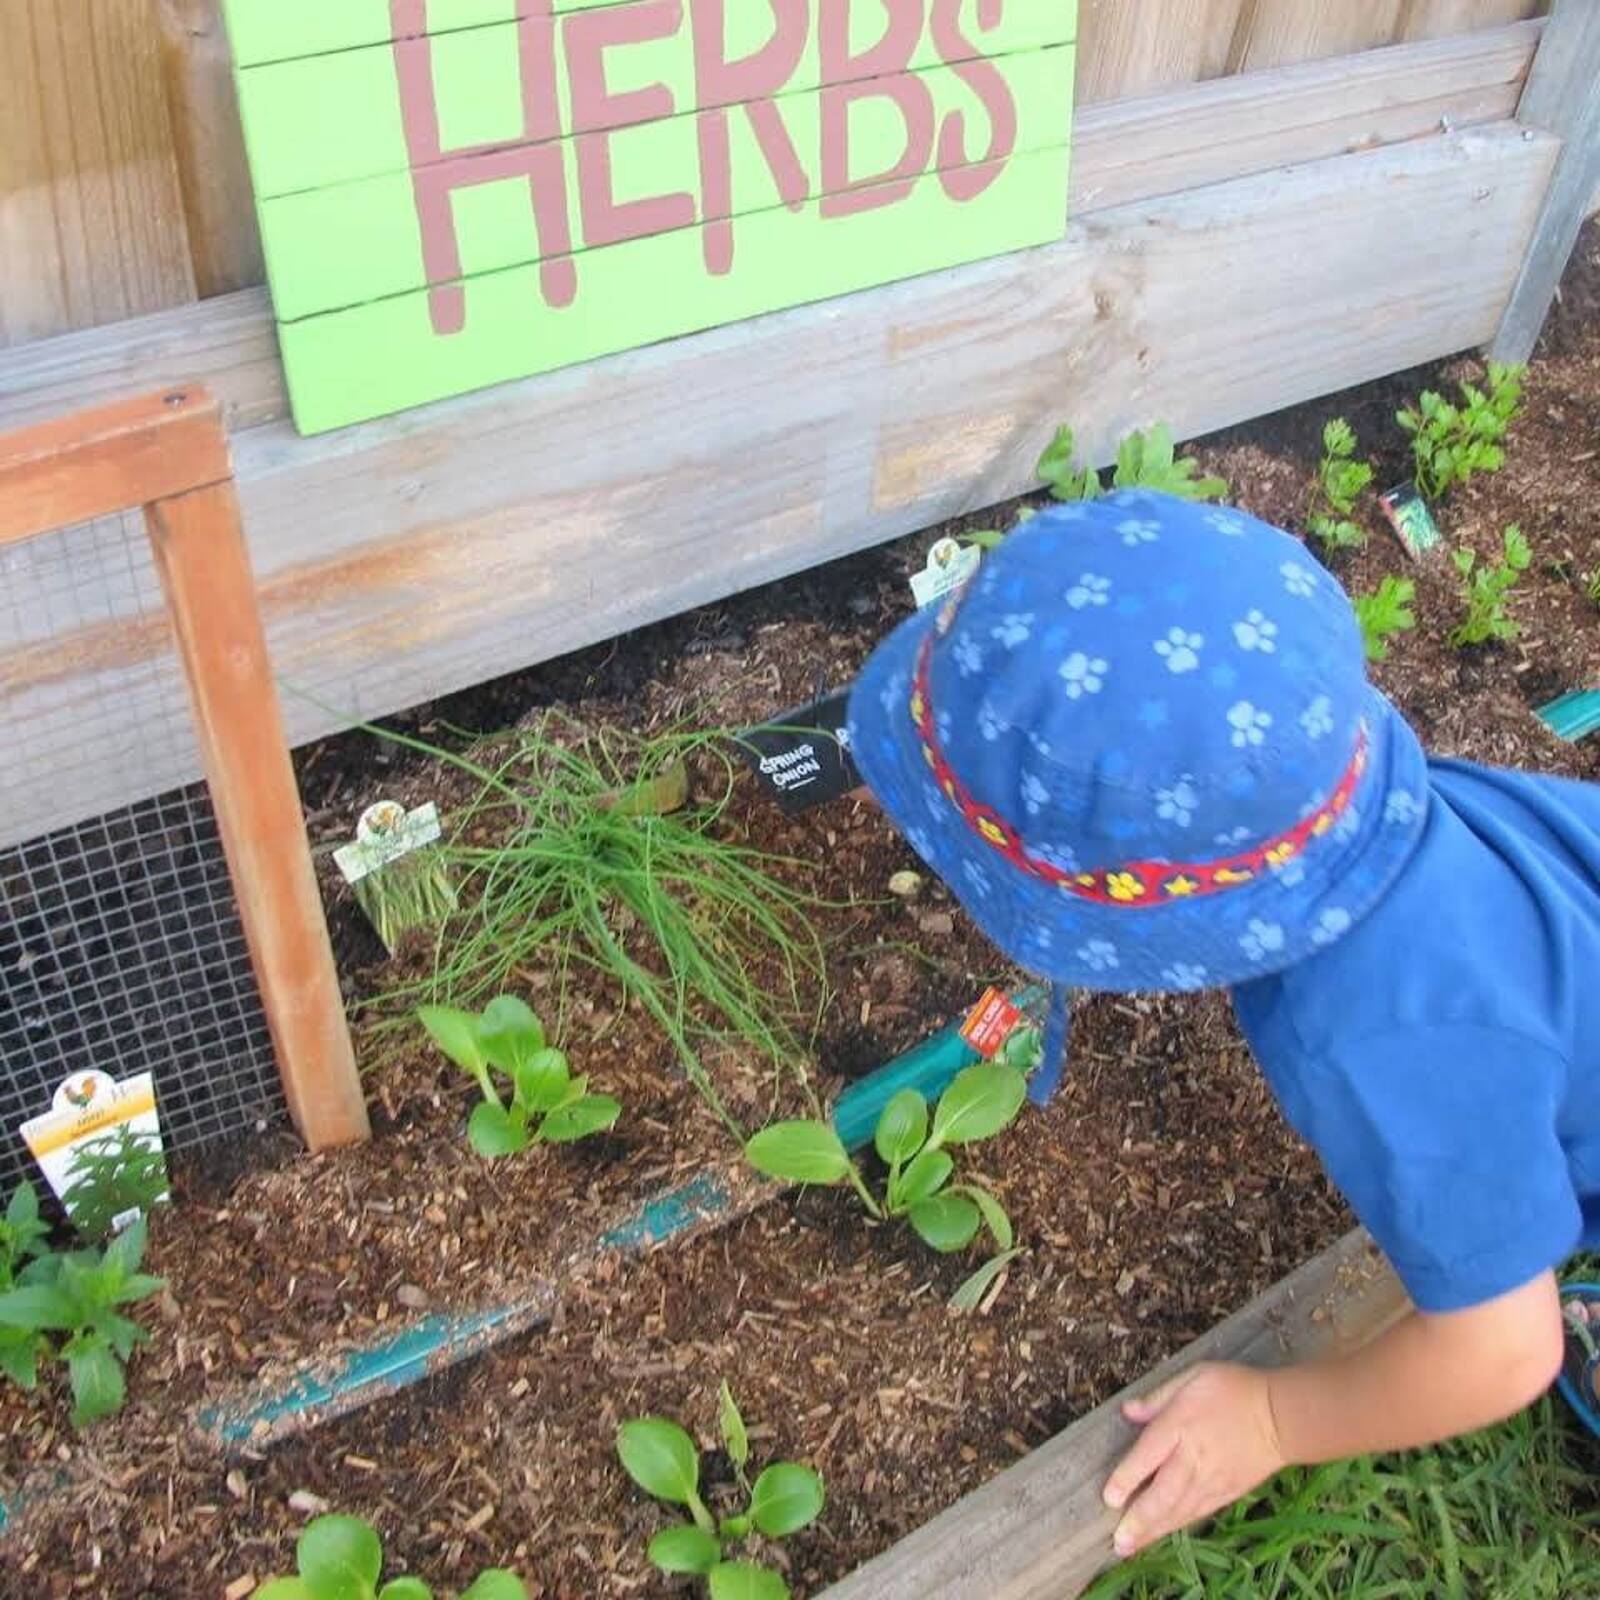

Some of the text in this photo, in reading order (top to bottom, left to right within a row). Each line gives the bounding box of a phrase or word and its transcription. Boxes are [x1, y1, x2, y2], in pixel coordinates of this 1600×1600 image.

[388, 0, 1018, 336] HERBS
[760, 744, 814, 774] SPRING
[773, 758, 820, 786] ONION
